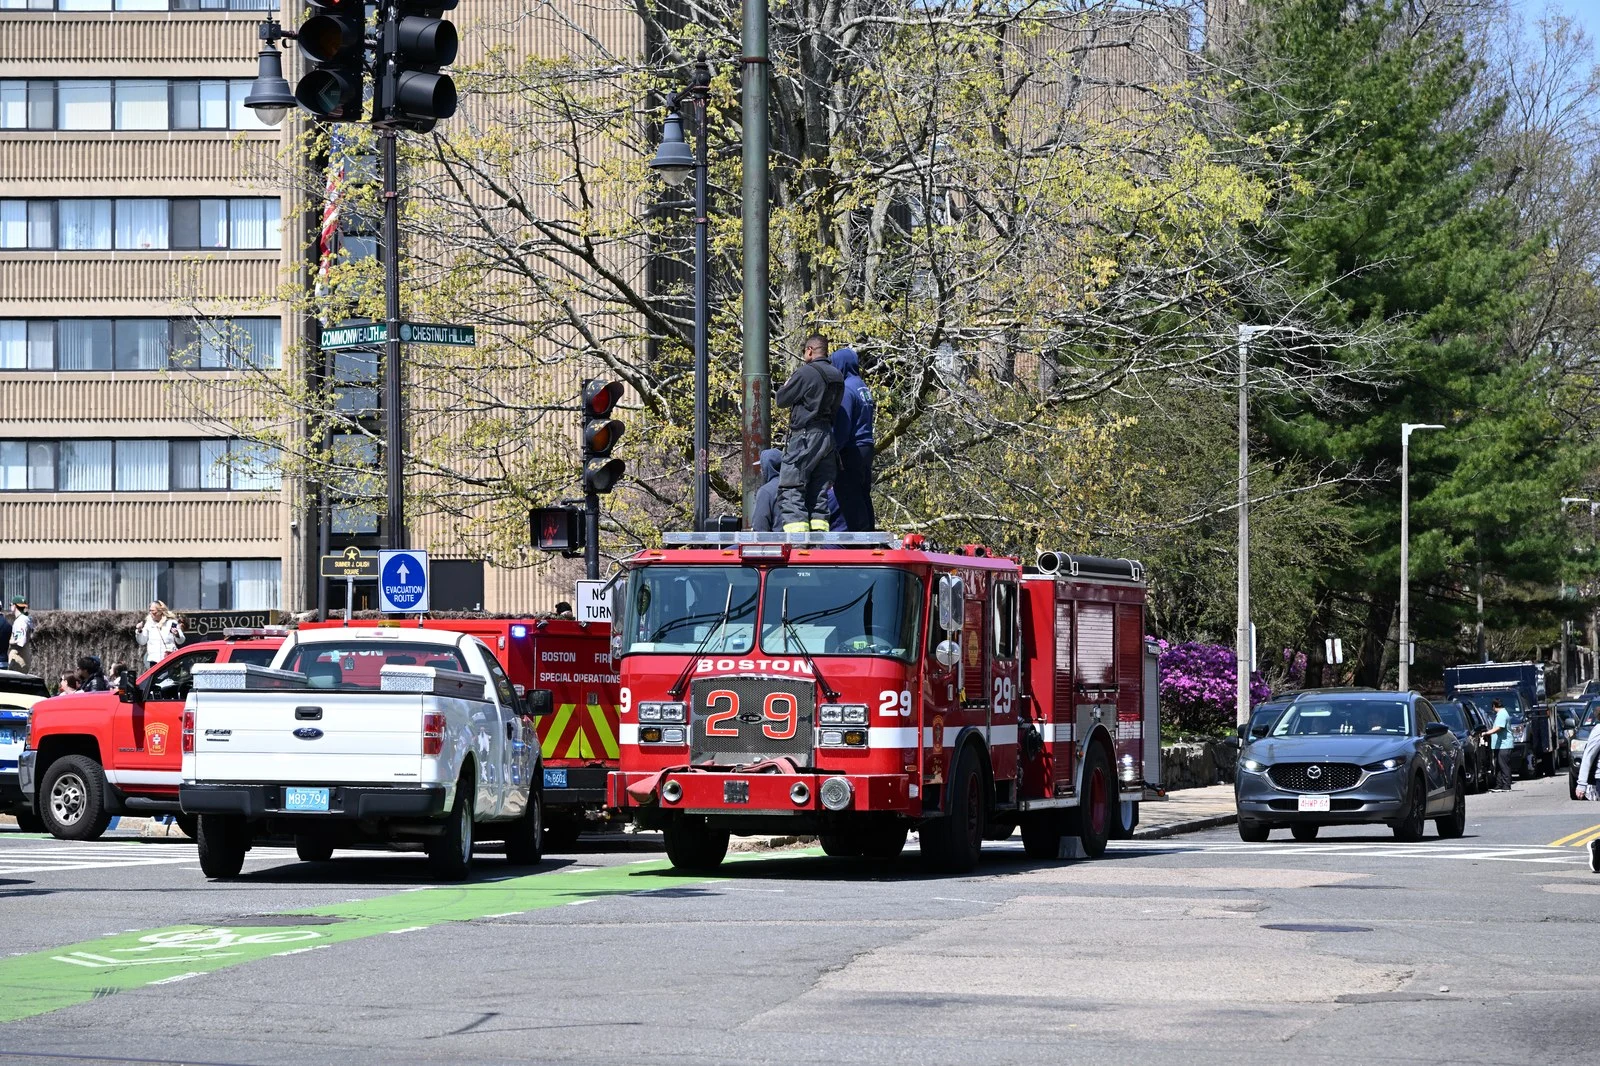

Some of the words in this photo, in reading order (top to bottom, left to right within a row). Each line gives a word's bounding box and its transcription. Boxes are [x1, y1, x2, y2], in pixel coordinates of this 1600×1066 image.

[321, 325, 379, 346] COMMONWEALTH
[412, 325, 448, 342] CHESTNUT
[448, 328, 466, 343] HILL
[465, 335, 474, 344] AVE
[385, 585, 423, 594] EVACUATION
[592, 588, 606, 600] NO
[393, 594, 415, 602] ROUTE
[586, 605, 612, 618] TURN
[189, 615, 265, 635] ESERVOIR
[541, 651, 576, 662] BOSTON
[696, 659, 813, 674] BOSTON
[540, 672, 572, 683] SPECIAL
[573, 673, 620, 684] OPERATIONS
[994, 677, 1011, 714] 29
[879, 690, 912, 717] 29
